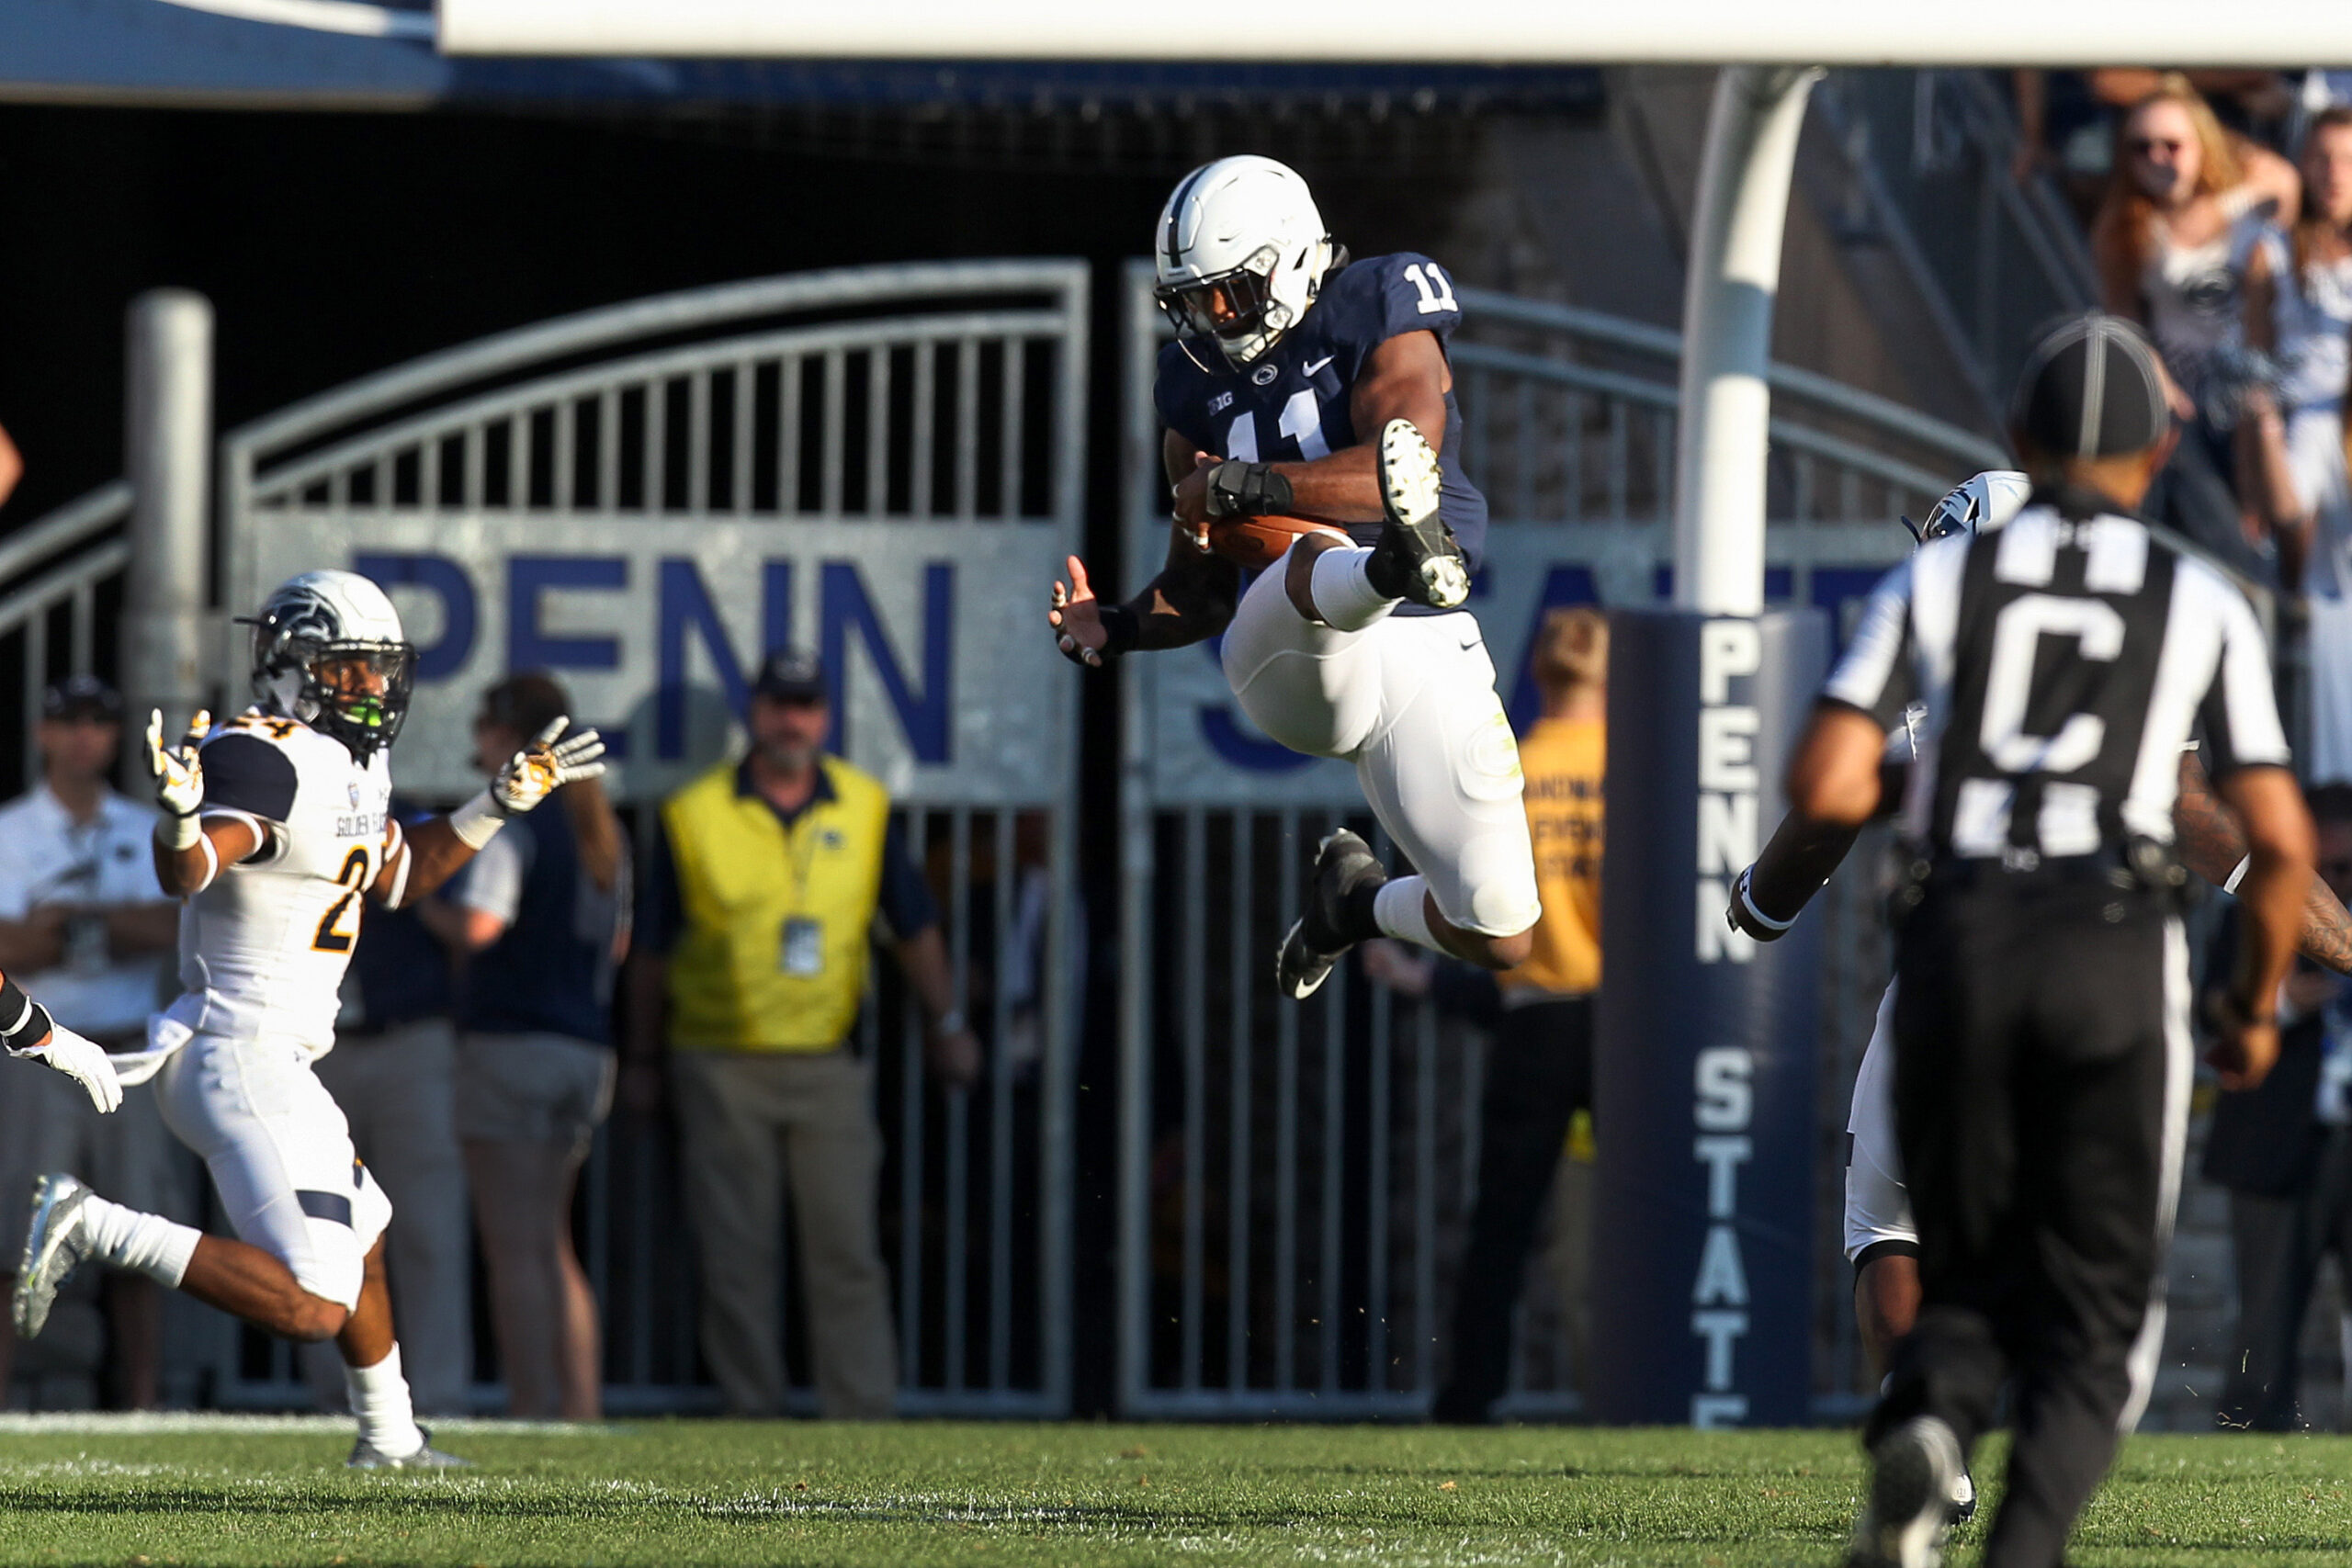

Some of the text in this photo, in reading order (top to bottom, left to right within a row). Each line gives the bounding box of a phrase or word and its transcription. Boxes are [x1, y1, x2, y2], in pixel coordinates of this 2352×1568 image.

[1403, 262, 1459, 314] 11
[1227, 387, 1331, 463] 11
[352, 554, 957, 766] PENN
[1979, 593, 2127, 773] C
[1696, 619, 1762, 964] PENN
[311, 843, 388, 953] 2
